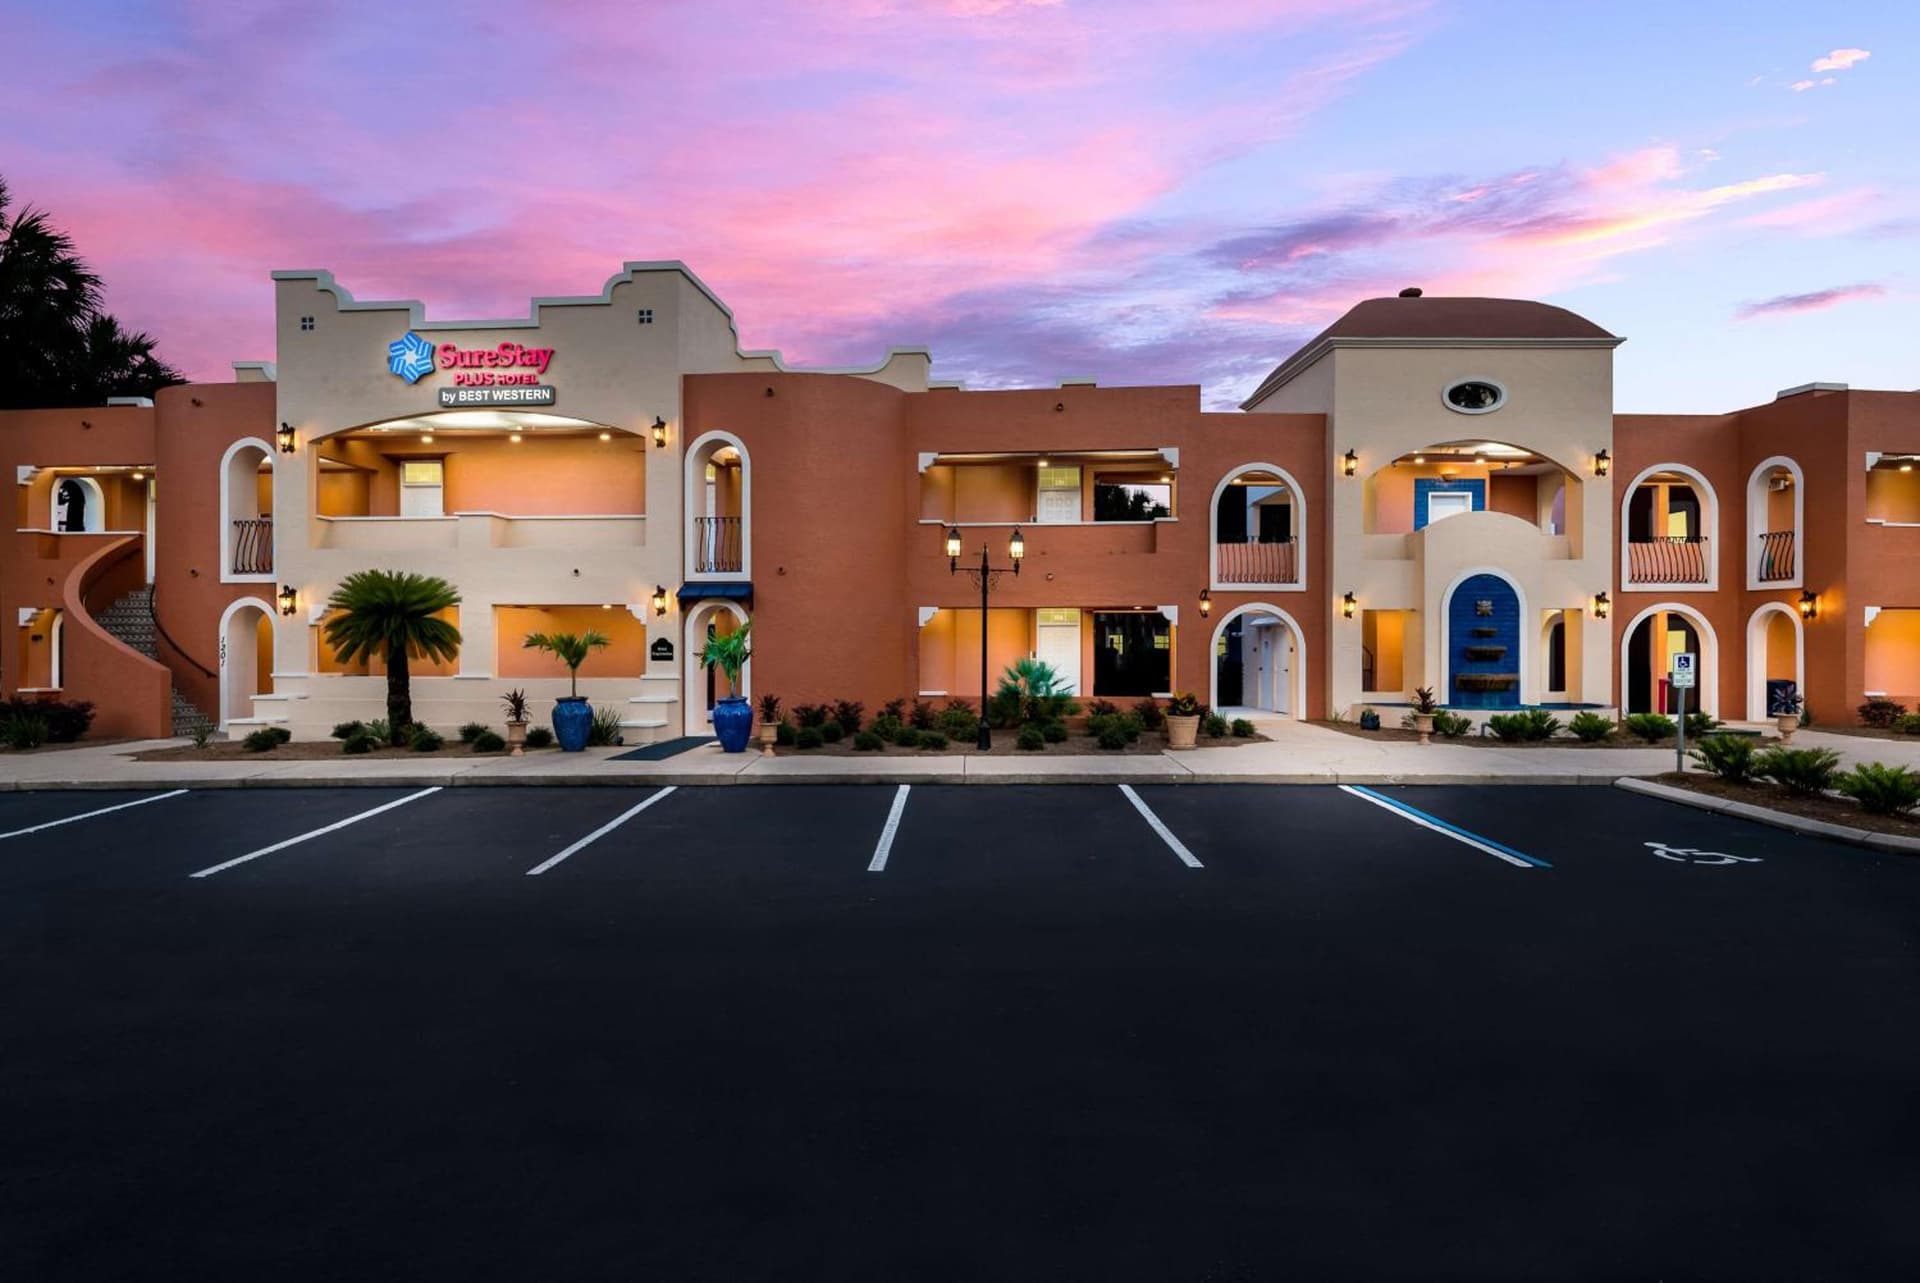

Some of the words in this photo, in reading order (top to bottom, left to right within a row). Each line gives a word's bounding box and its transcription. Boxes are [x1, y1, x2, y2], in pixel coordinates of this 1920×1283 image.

[439, 342, 553, 374] SureStay
[455, 373, 494, 386] PLUS
[497, 373, 539, 386] HOTEL
[442, 391, 455, 404] by
[459, 390, 490, 402] BEST
[492, 388, 551, 401] WESTERN
